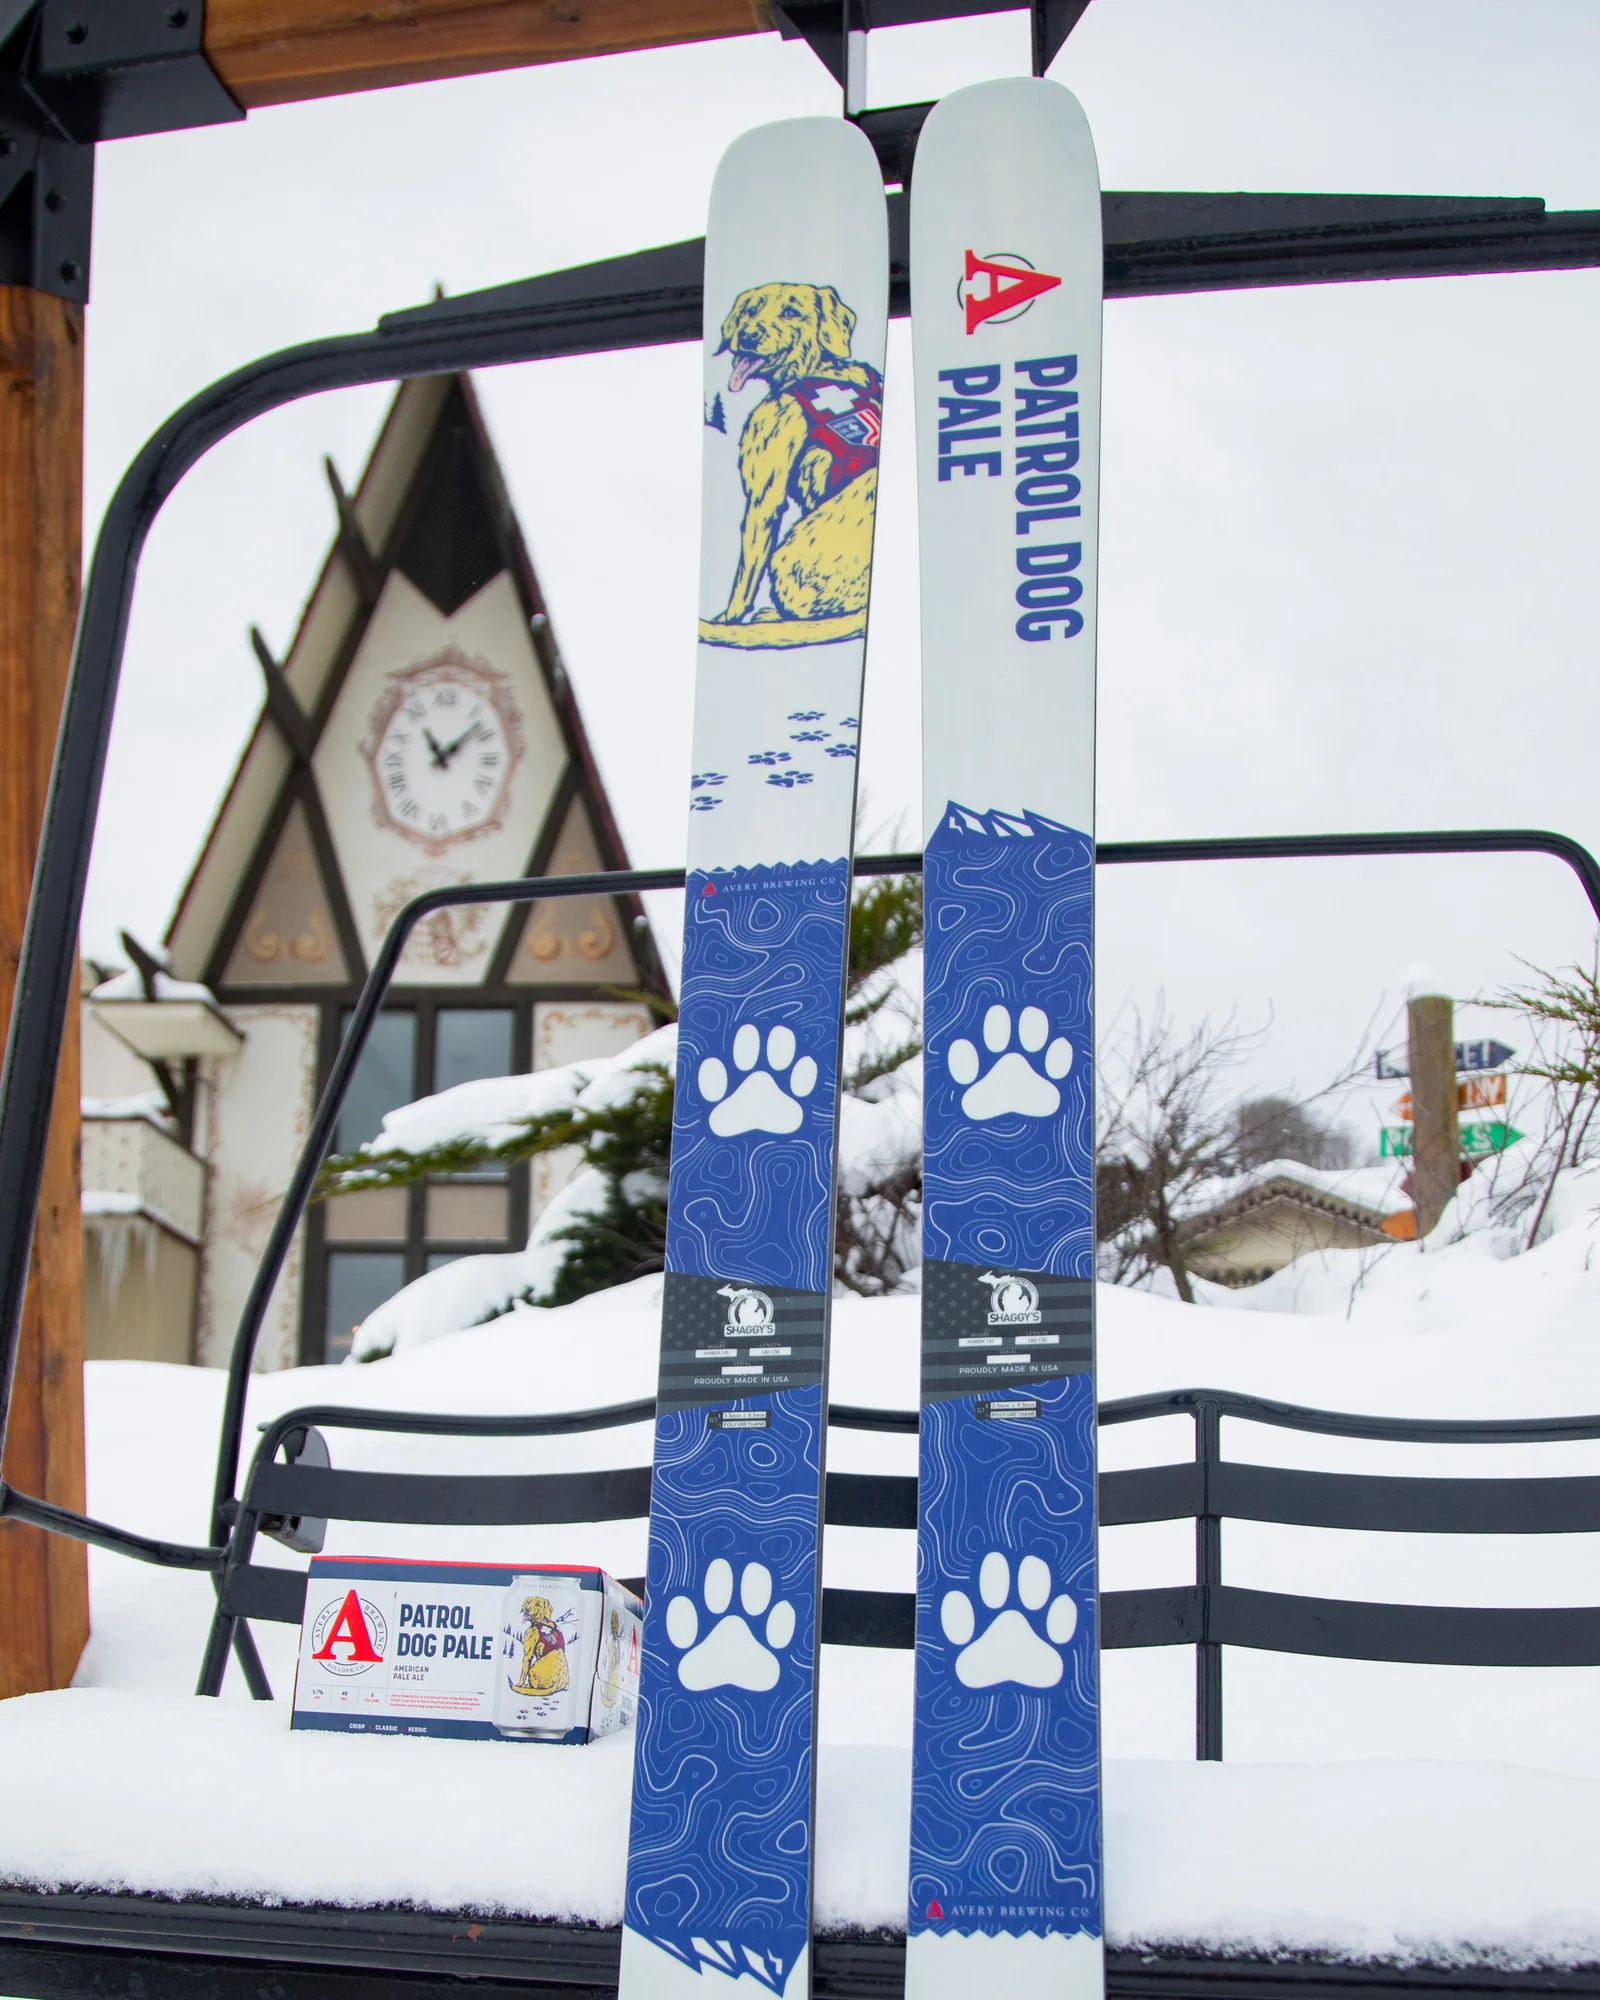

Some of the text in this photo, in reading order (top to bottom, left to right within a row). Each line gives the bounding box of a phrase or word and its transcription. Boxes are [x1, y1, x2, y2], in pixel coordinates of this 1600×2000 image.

[965, 249, 1062, 335] A
[938, 363, 1002, 482] PALE
[1014, 354, 1084, 642] PATROL DOG
[722, 882, 758, 893] AVERY
[763, 878, 816, 889] BREWING
[990, 1312, 1039, 1323] SHAGGY'S
[726, 1324, 774, 1335] SHAGGY'S
[1041, 1364, 1058, 1372] USA
[312, 1589, 383, 1662] A
[400, 1604, 474, 1630] PATROL
[315, 1605, 385, 1650] AVERY BREWING
[397, 1633, 493, 1660] DOG PALE
[393, 1665, 429, 1673] AMERICAN
[375, 1724, 398, 1732] CLASSIC
[951, 1905, 995, 1916] AVERY
[1000, 1905, 1065, 1917] BREWING
